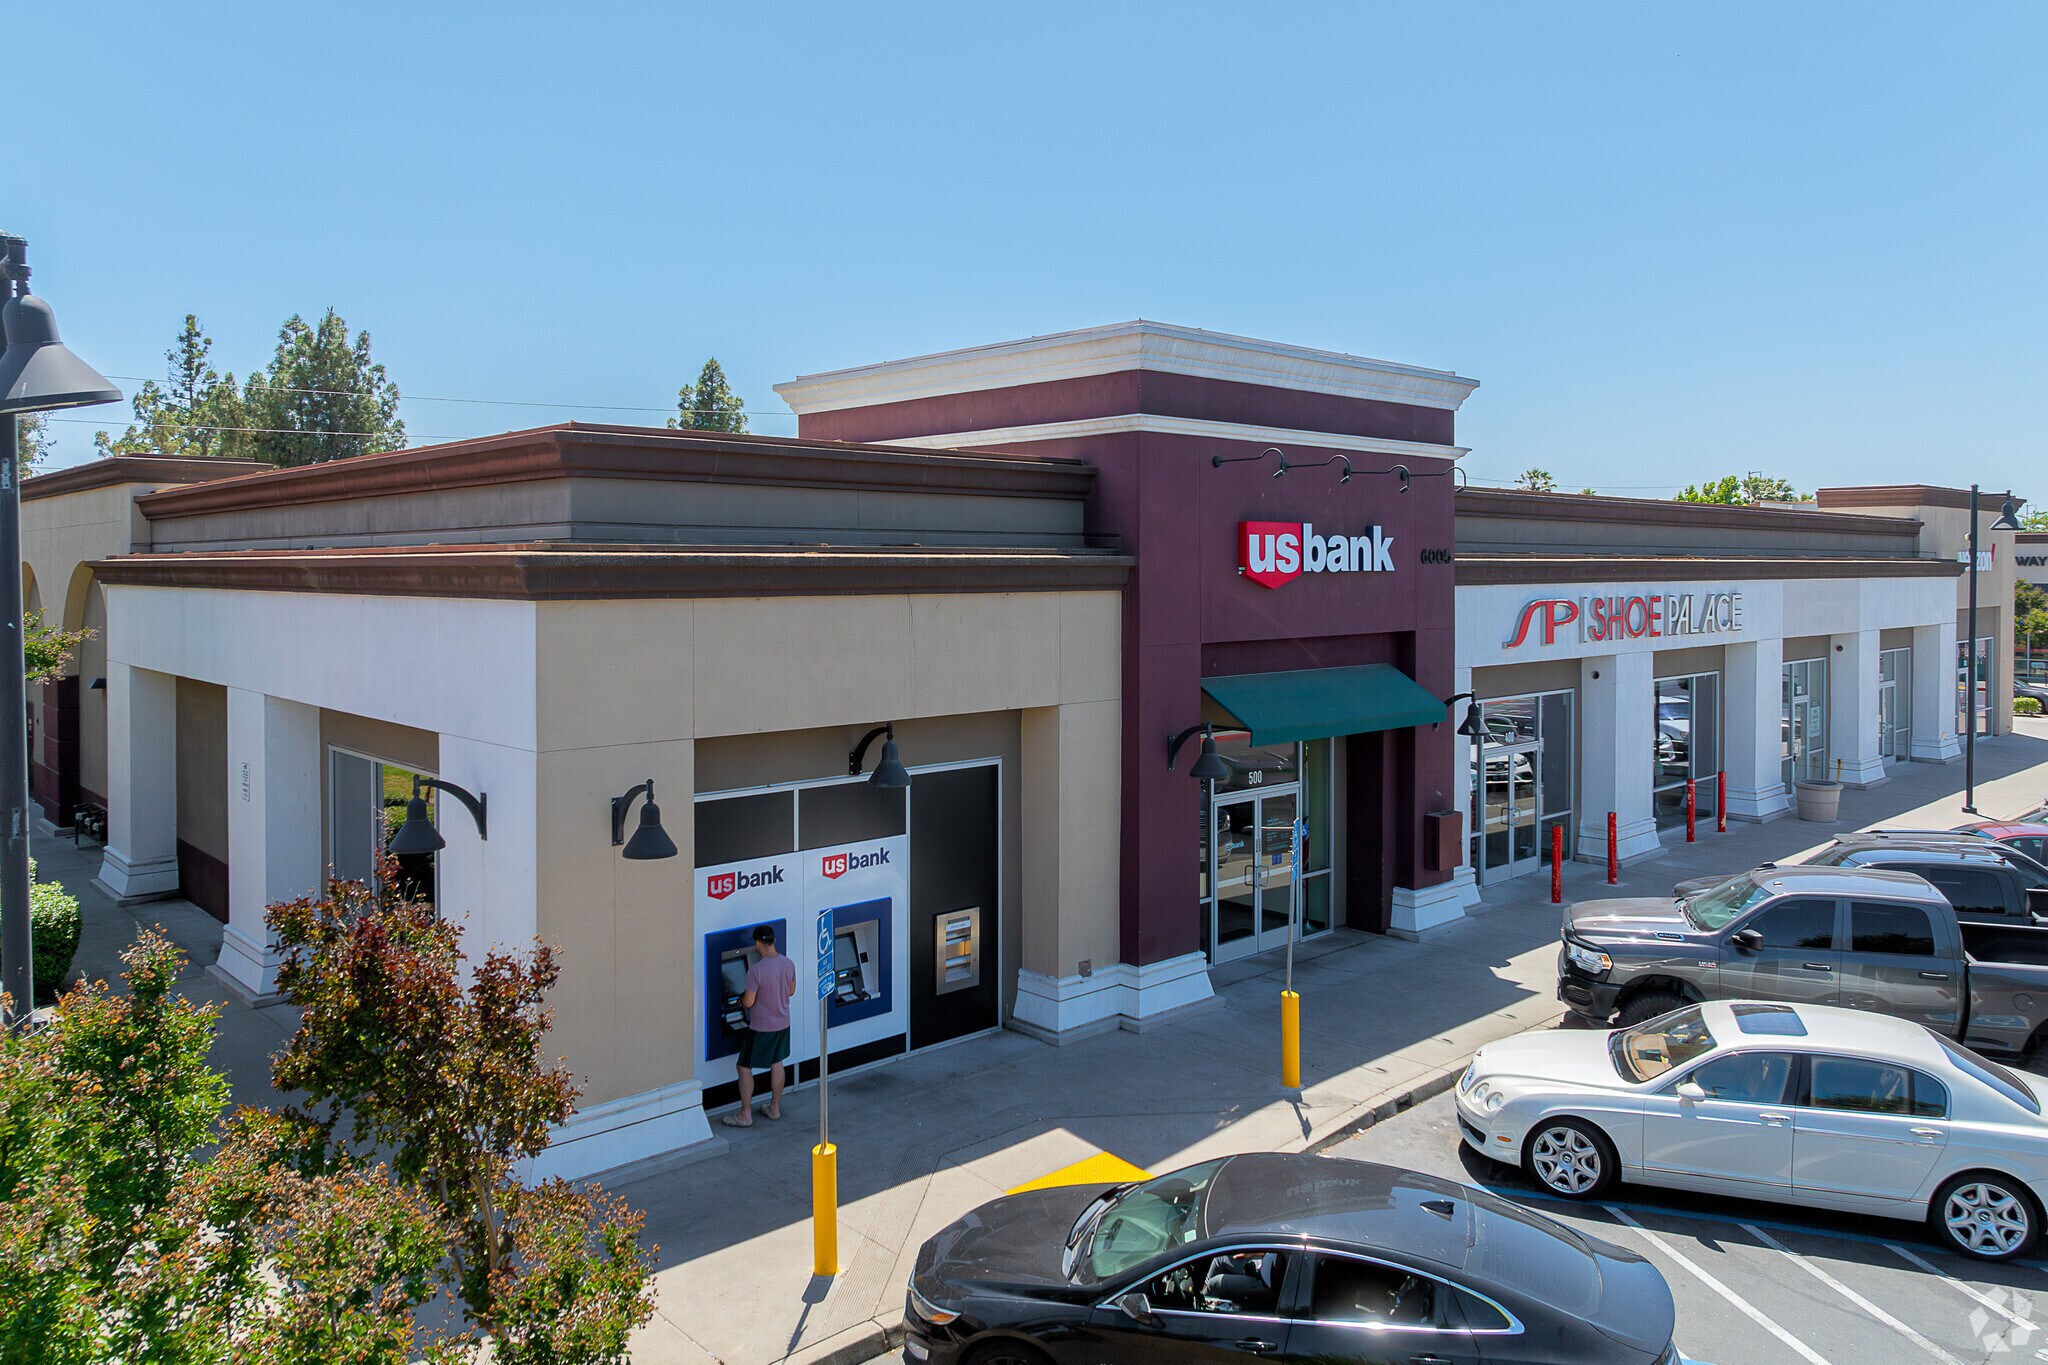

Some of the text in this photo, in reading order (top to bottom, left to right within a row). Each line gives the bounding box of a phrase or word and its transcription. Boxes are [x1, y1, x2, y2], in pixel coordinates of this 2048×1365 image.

[1420, 548, 1451, 564] 6005
[1590, 596, 1662, 641] SHOE
[1666, 593, 1743, 637] PALACE
[1248, 770, 1262, 785] 500
